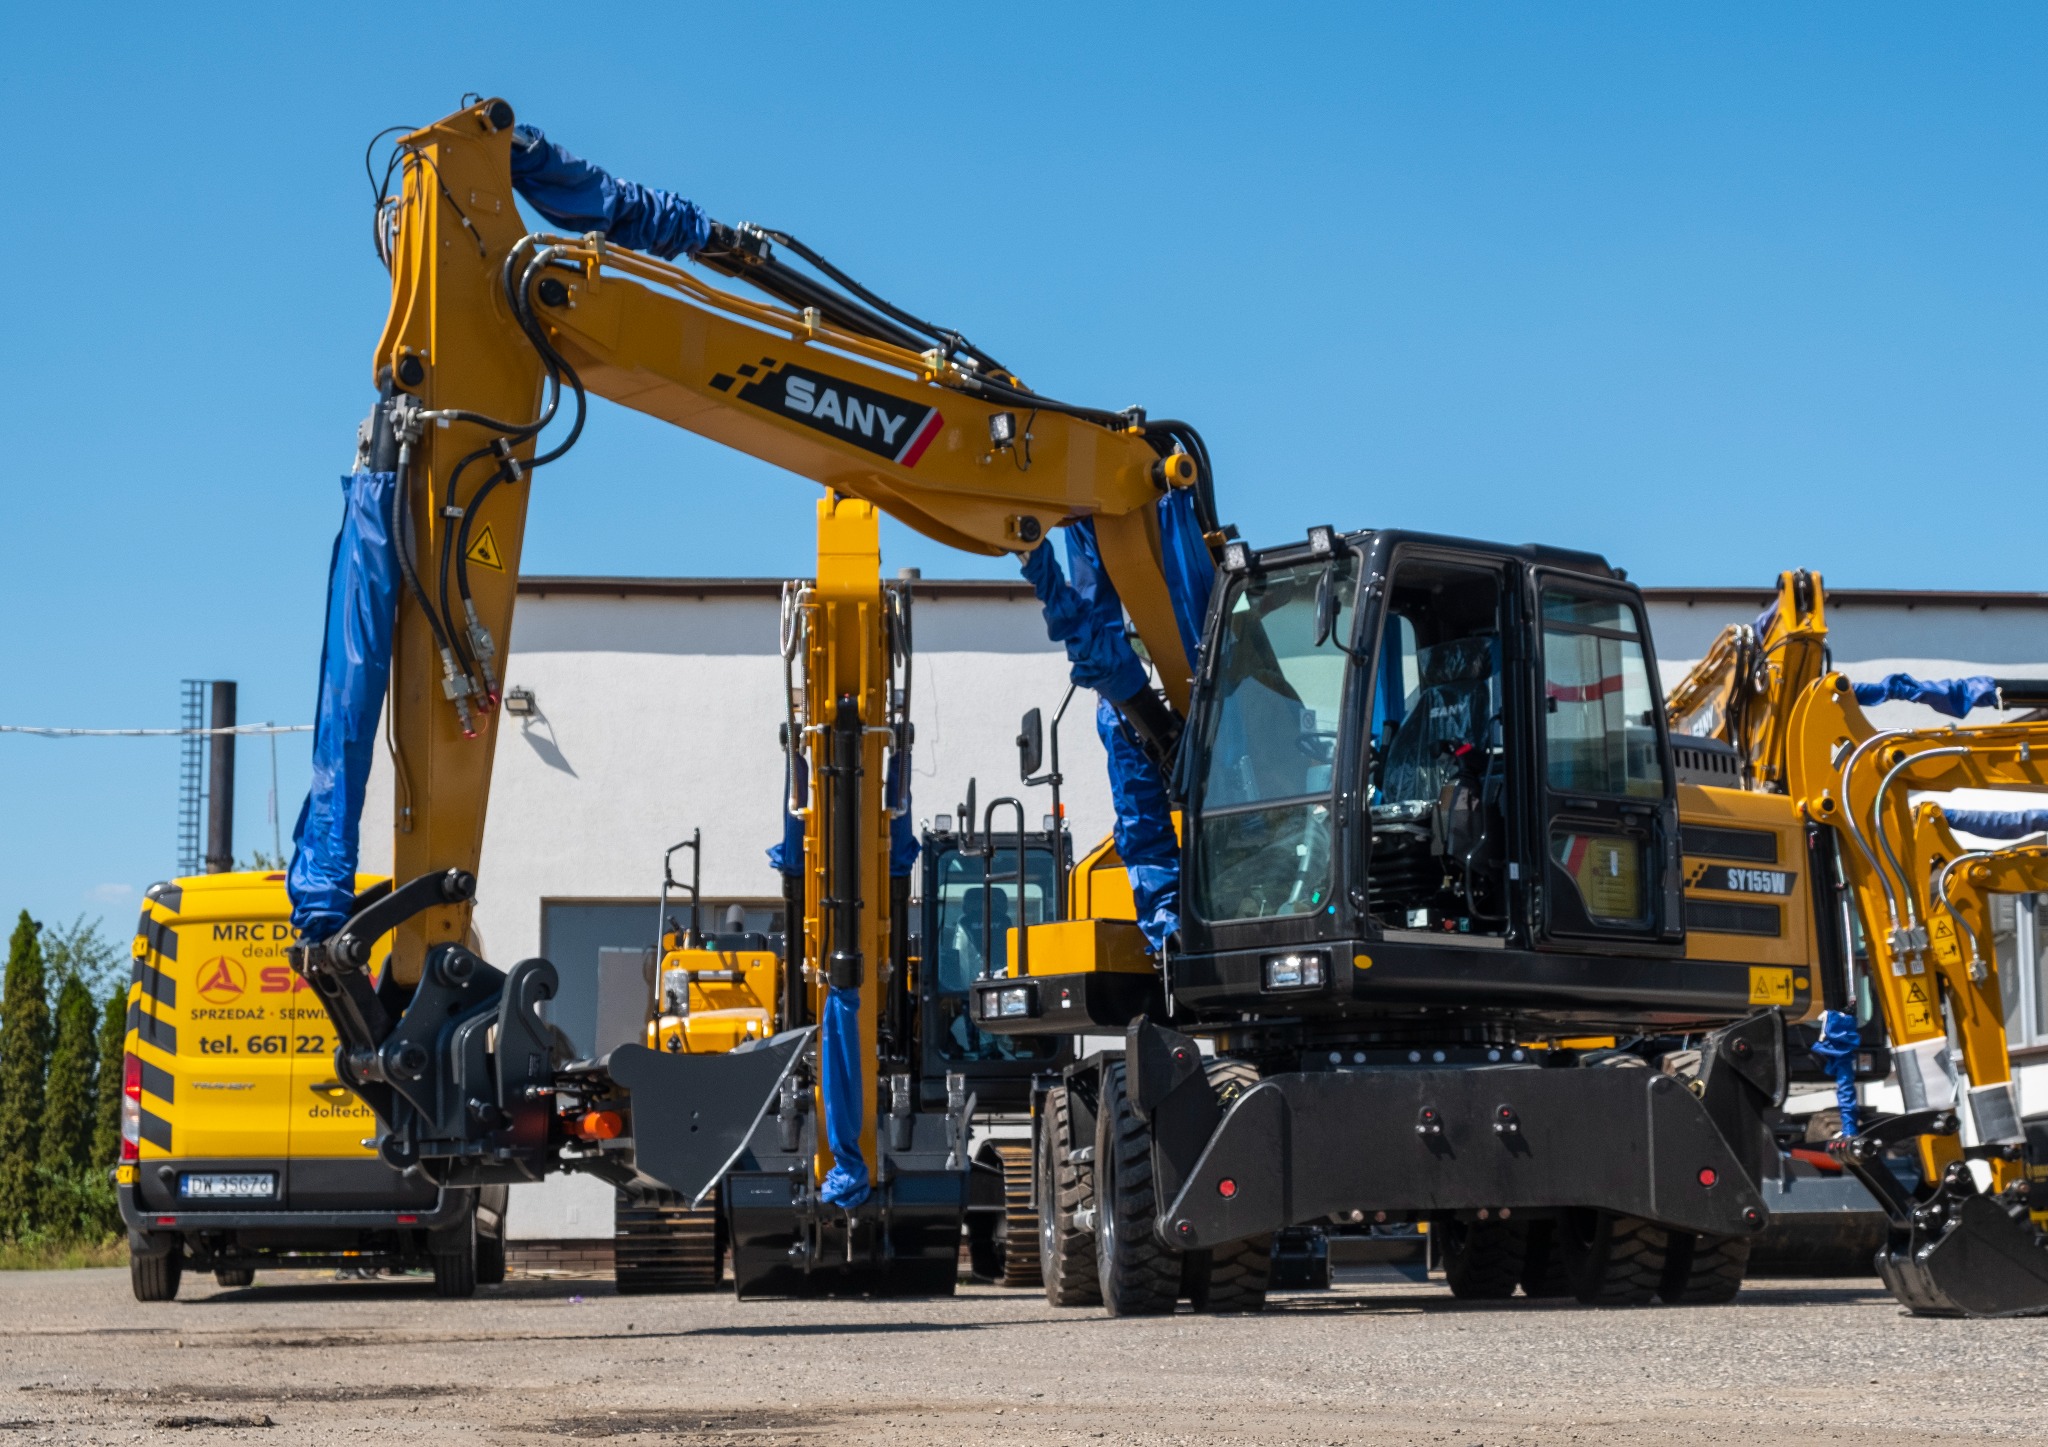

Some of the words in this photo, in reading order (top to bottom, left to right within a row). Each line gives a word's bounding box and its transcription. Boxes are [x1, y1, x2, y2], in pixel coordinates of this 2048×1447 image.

[785, 375, 906, 446] SANY
[1728, 868, 1786, 894] SY155W
[213, 924, 265, 941] MRC
[191, 1006, 265, 1020] SPRZEDAŻ
[279, 1008, 330, 1020] SERWI
[199, 1035, 239, 1054] tel.
[247, 1036, 287, 1054] 661
[296, 1036, 325, 1054] 22
[193, 1177, 213, 1194] DW
